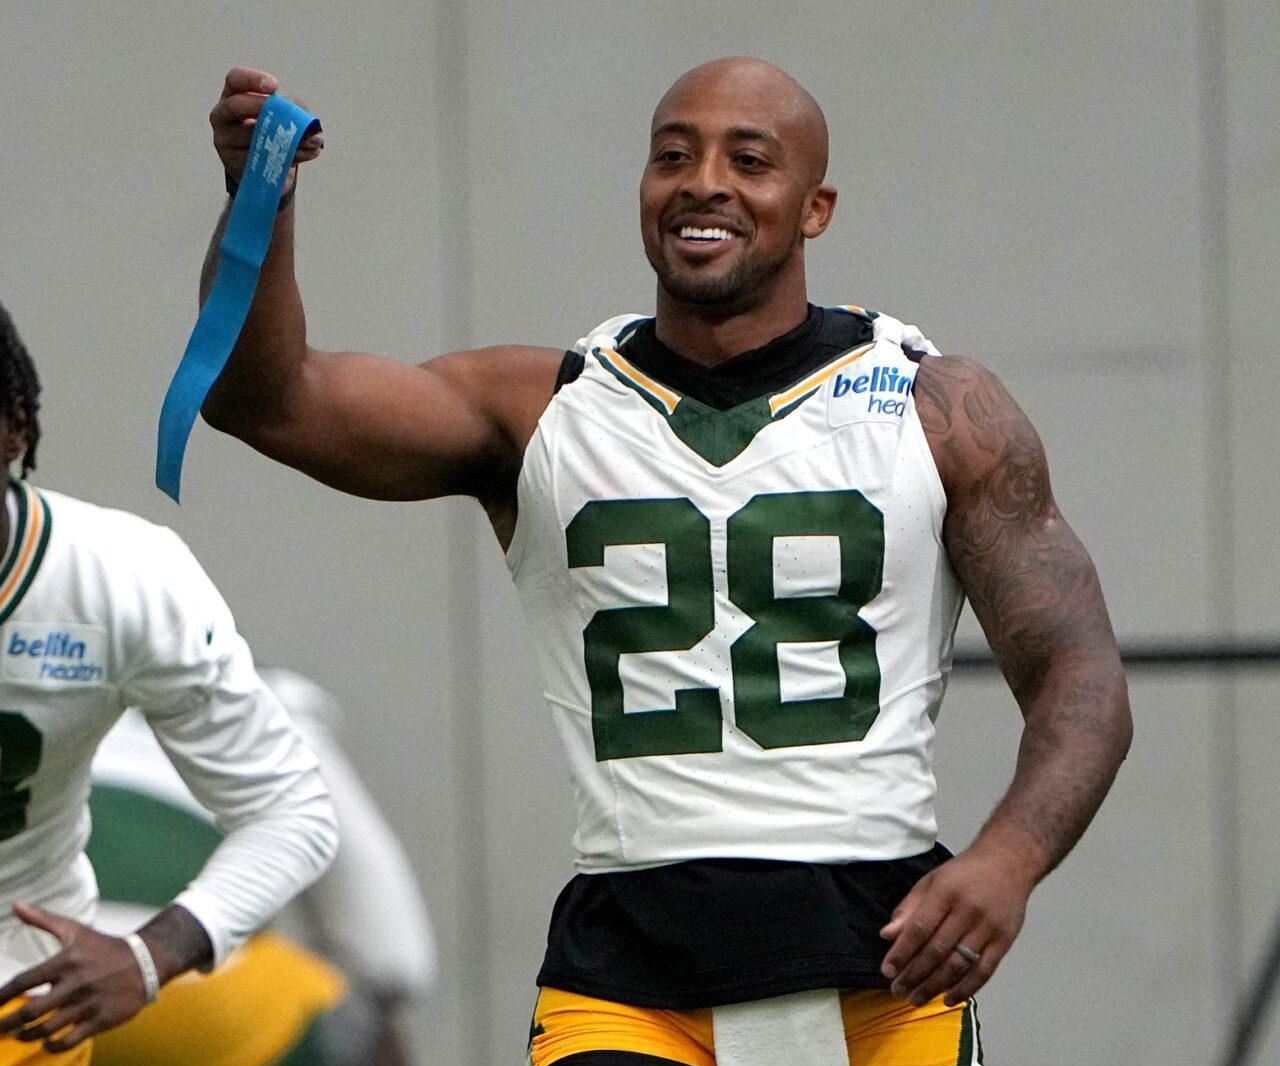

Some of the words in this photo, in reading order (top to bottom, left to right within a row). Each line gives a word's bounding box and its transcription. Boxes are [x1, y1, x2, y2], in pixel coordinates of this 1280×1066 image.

[832, 366, 912, 398] bellin
[565, 490, 886, 762] 28
[7, 631, 86, 659] bellin
